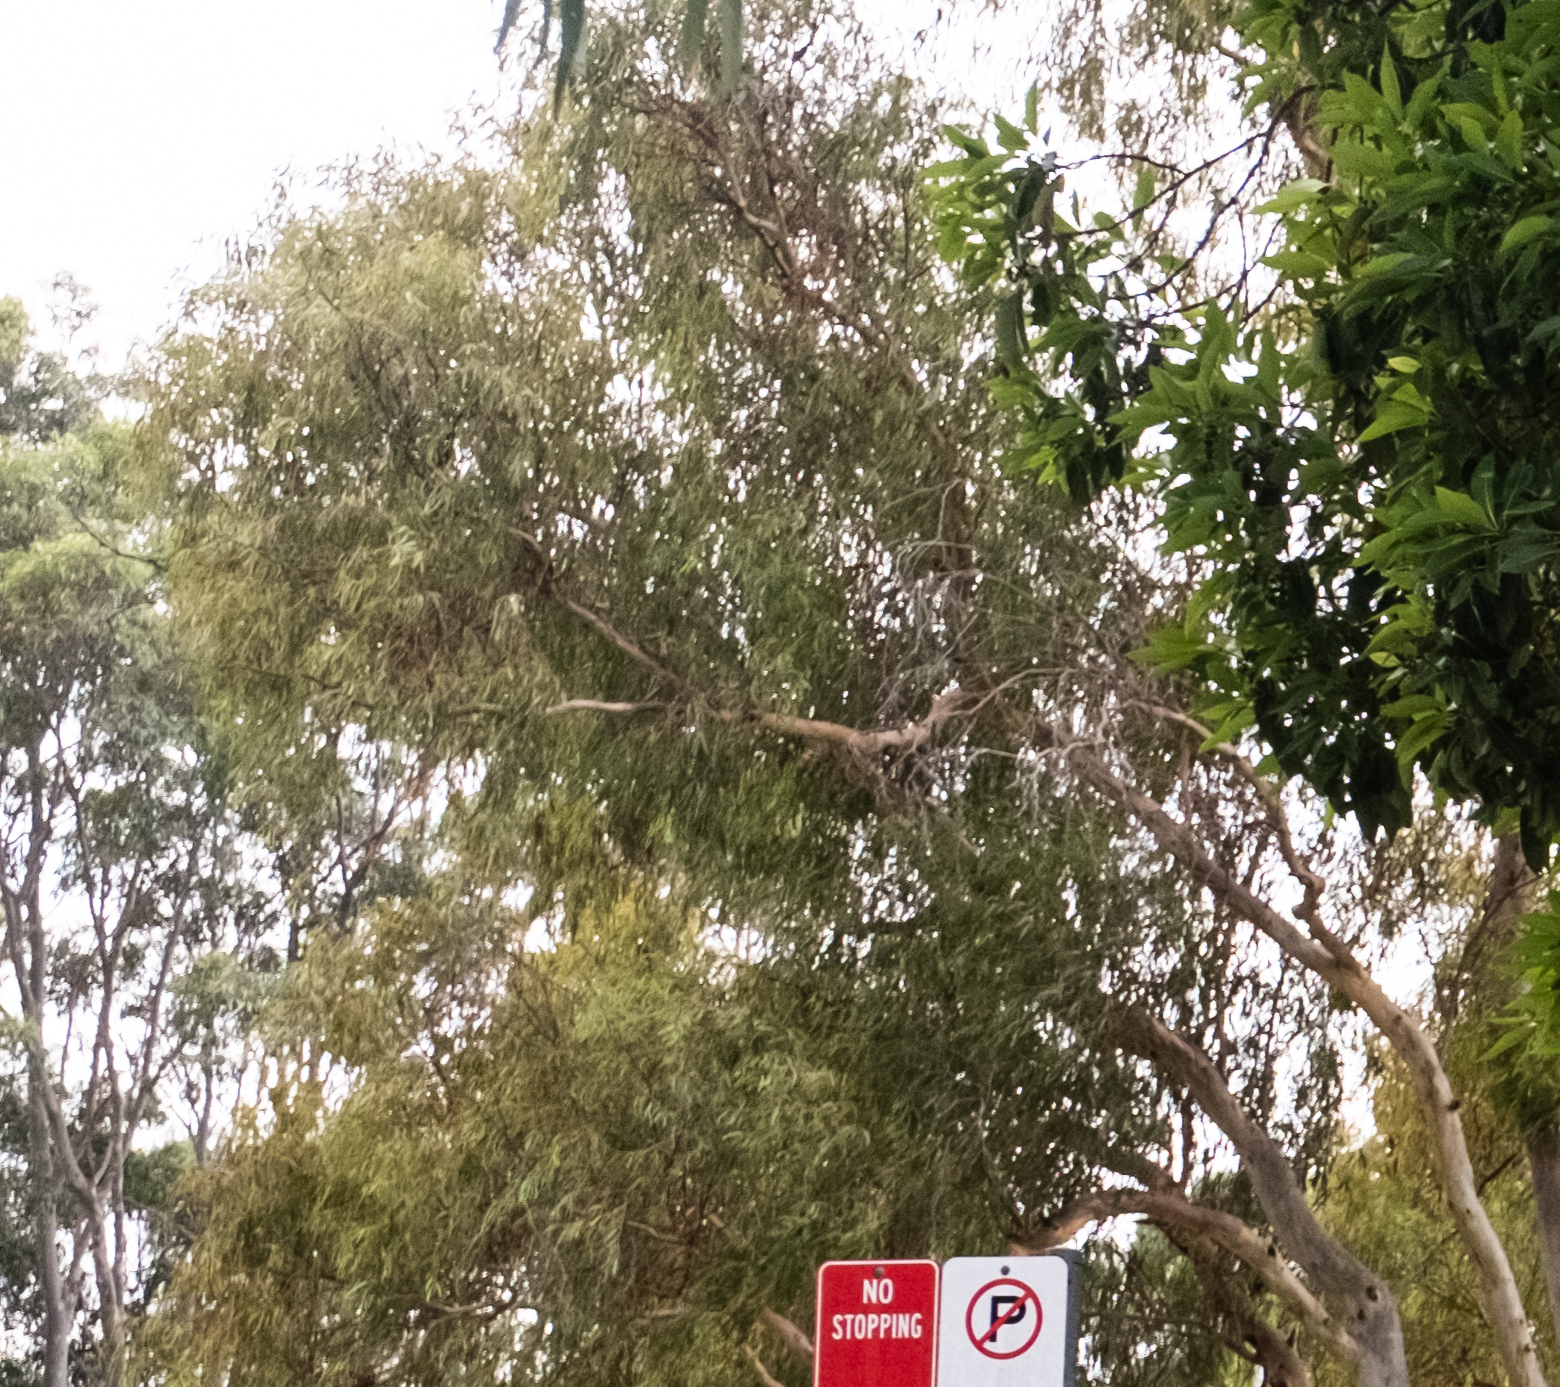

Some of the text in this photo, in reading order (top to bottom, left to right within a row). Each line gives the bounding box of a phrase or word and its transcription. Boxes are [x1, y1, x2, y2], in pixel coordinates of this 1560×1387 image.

[862, 1279, 894, 1304] NO
[831, 1313, 922, 1340] STOPPING
[991, 1295, 1026, 1343] P
